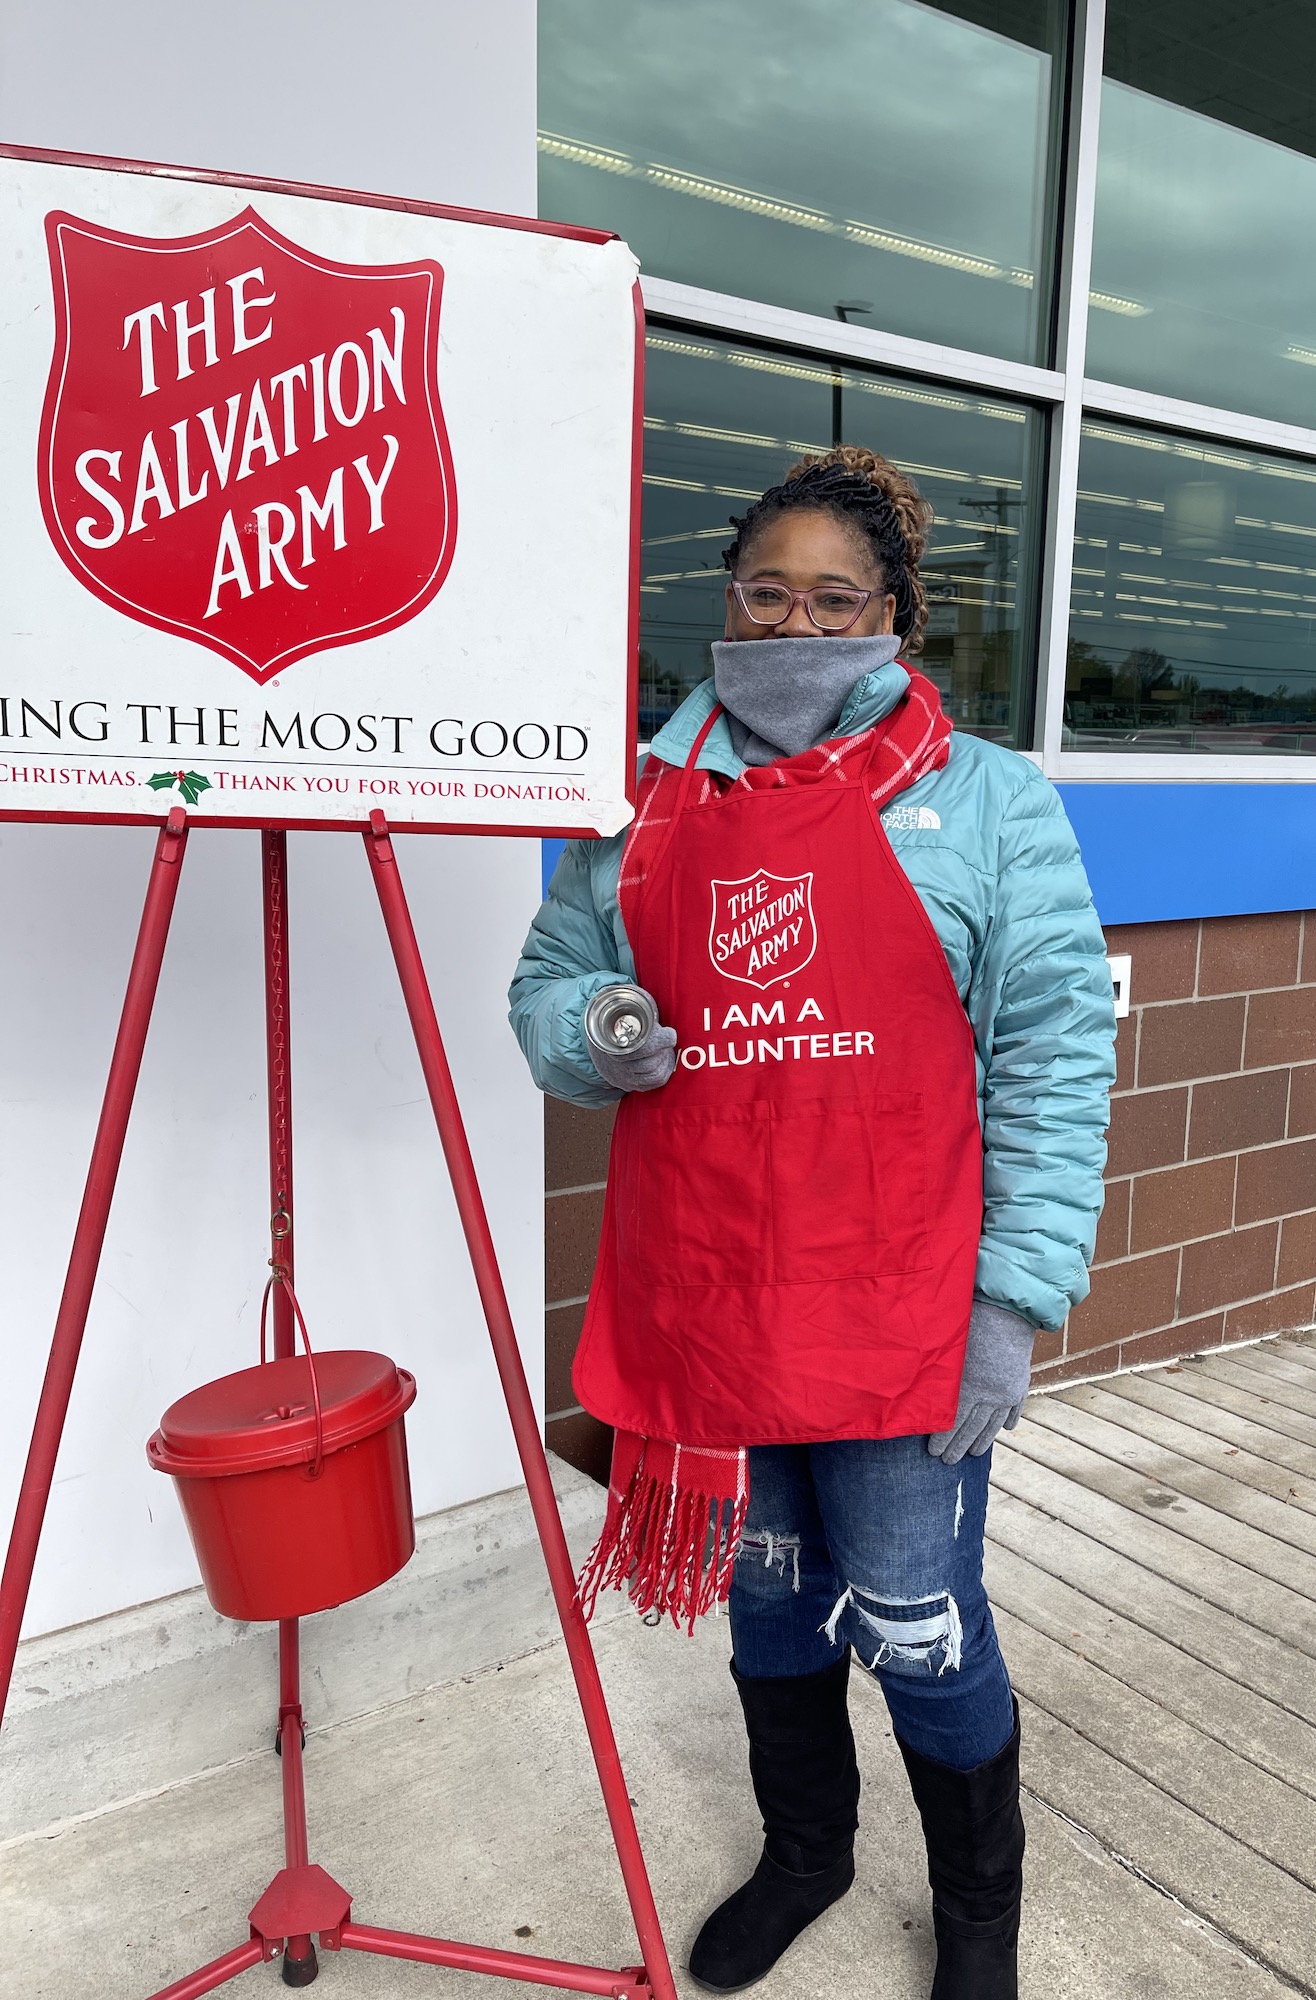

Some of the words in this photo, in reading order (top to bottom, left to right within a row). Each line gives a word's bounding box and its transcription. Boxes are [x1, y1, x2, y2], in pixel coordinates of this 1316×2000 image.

[121, 266, 277, 398] THE
[74, 306, 407, 550] SALVATION
[202, 434, 400, 620] ARMY
[125, 703, 240, 747] THE
[258, 710, 413, 754] MOST
[429, 718, 589, 761] GOOD
[302, 777, 350, 794] YOU
[358, 778, 402, 795] FOR
[406, 780, 467, 798] YOUR
[473, 783, 592, 802] DONATION.
[893, 805, 919, 815] THE
[885, 820, 918, 830] FACE
[715, 881, 806, 962] SALVATION
[727, 879, 770, 921] THE
[746, 916, 804, 977] ARMY
[703, 1007, 711, 1032] I
[721, 1000, 786, 1030] AM
[796, 997, 825, 1023] A
